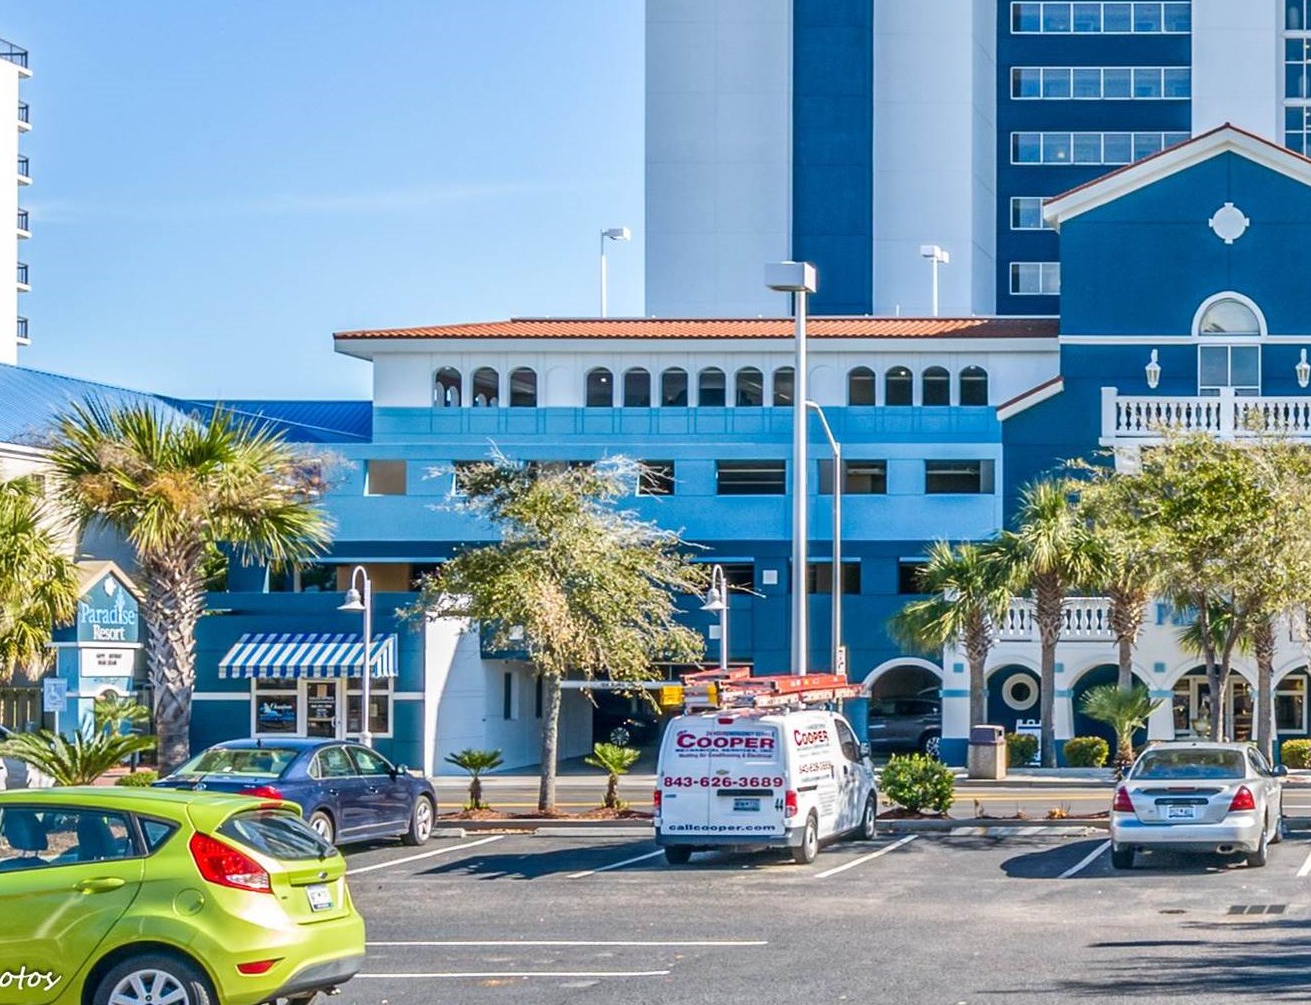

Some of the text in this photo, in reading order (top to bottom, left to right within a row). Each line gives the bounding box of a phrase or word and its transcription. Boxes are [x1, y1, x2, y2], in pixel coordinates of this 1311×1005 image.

[81, 601, 136, 625] Paradise
[92, 623, 126, 641] Resort
[676, 733, 775, 749] COOPER
[794, 730, 830, 747] COOPER
[664, 777, 783, 787] 843-626-3689
[668, 824, 776, 832] callcooper.com
